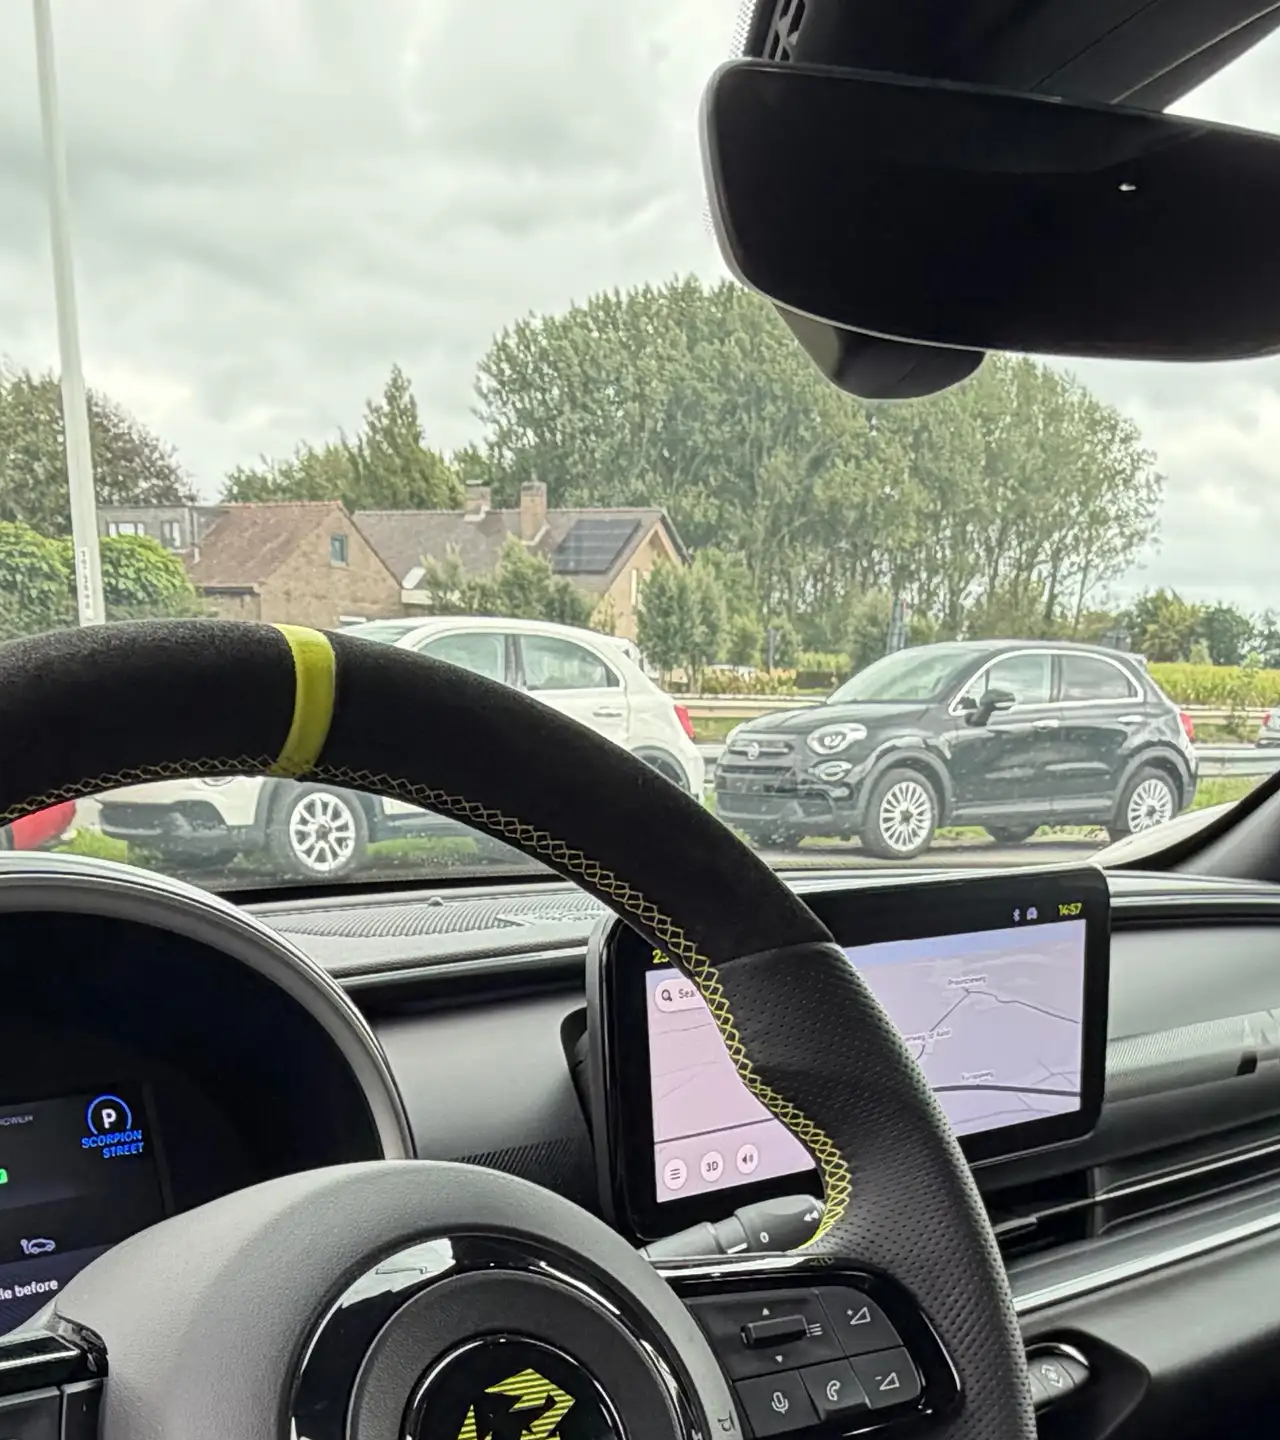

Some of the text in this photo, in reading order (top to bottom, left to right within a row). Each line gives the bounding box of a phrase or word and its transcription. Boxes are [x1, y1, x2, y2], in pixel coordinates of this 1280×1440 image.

[101, 1108, 117, 1129] P
[81, 1130, 142, 1149] SCORPION
[102, 1141, 145, 1159] STREET
[706, 1161, 719, 1173] 3D
[14, 1279, 59, 1298] before
